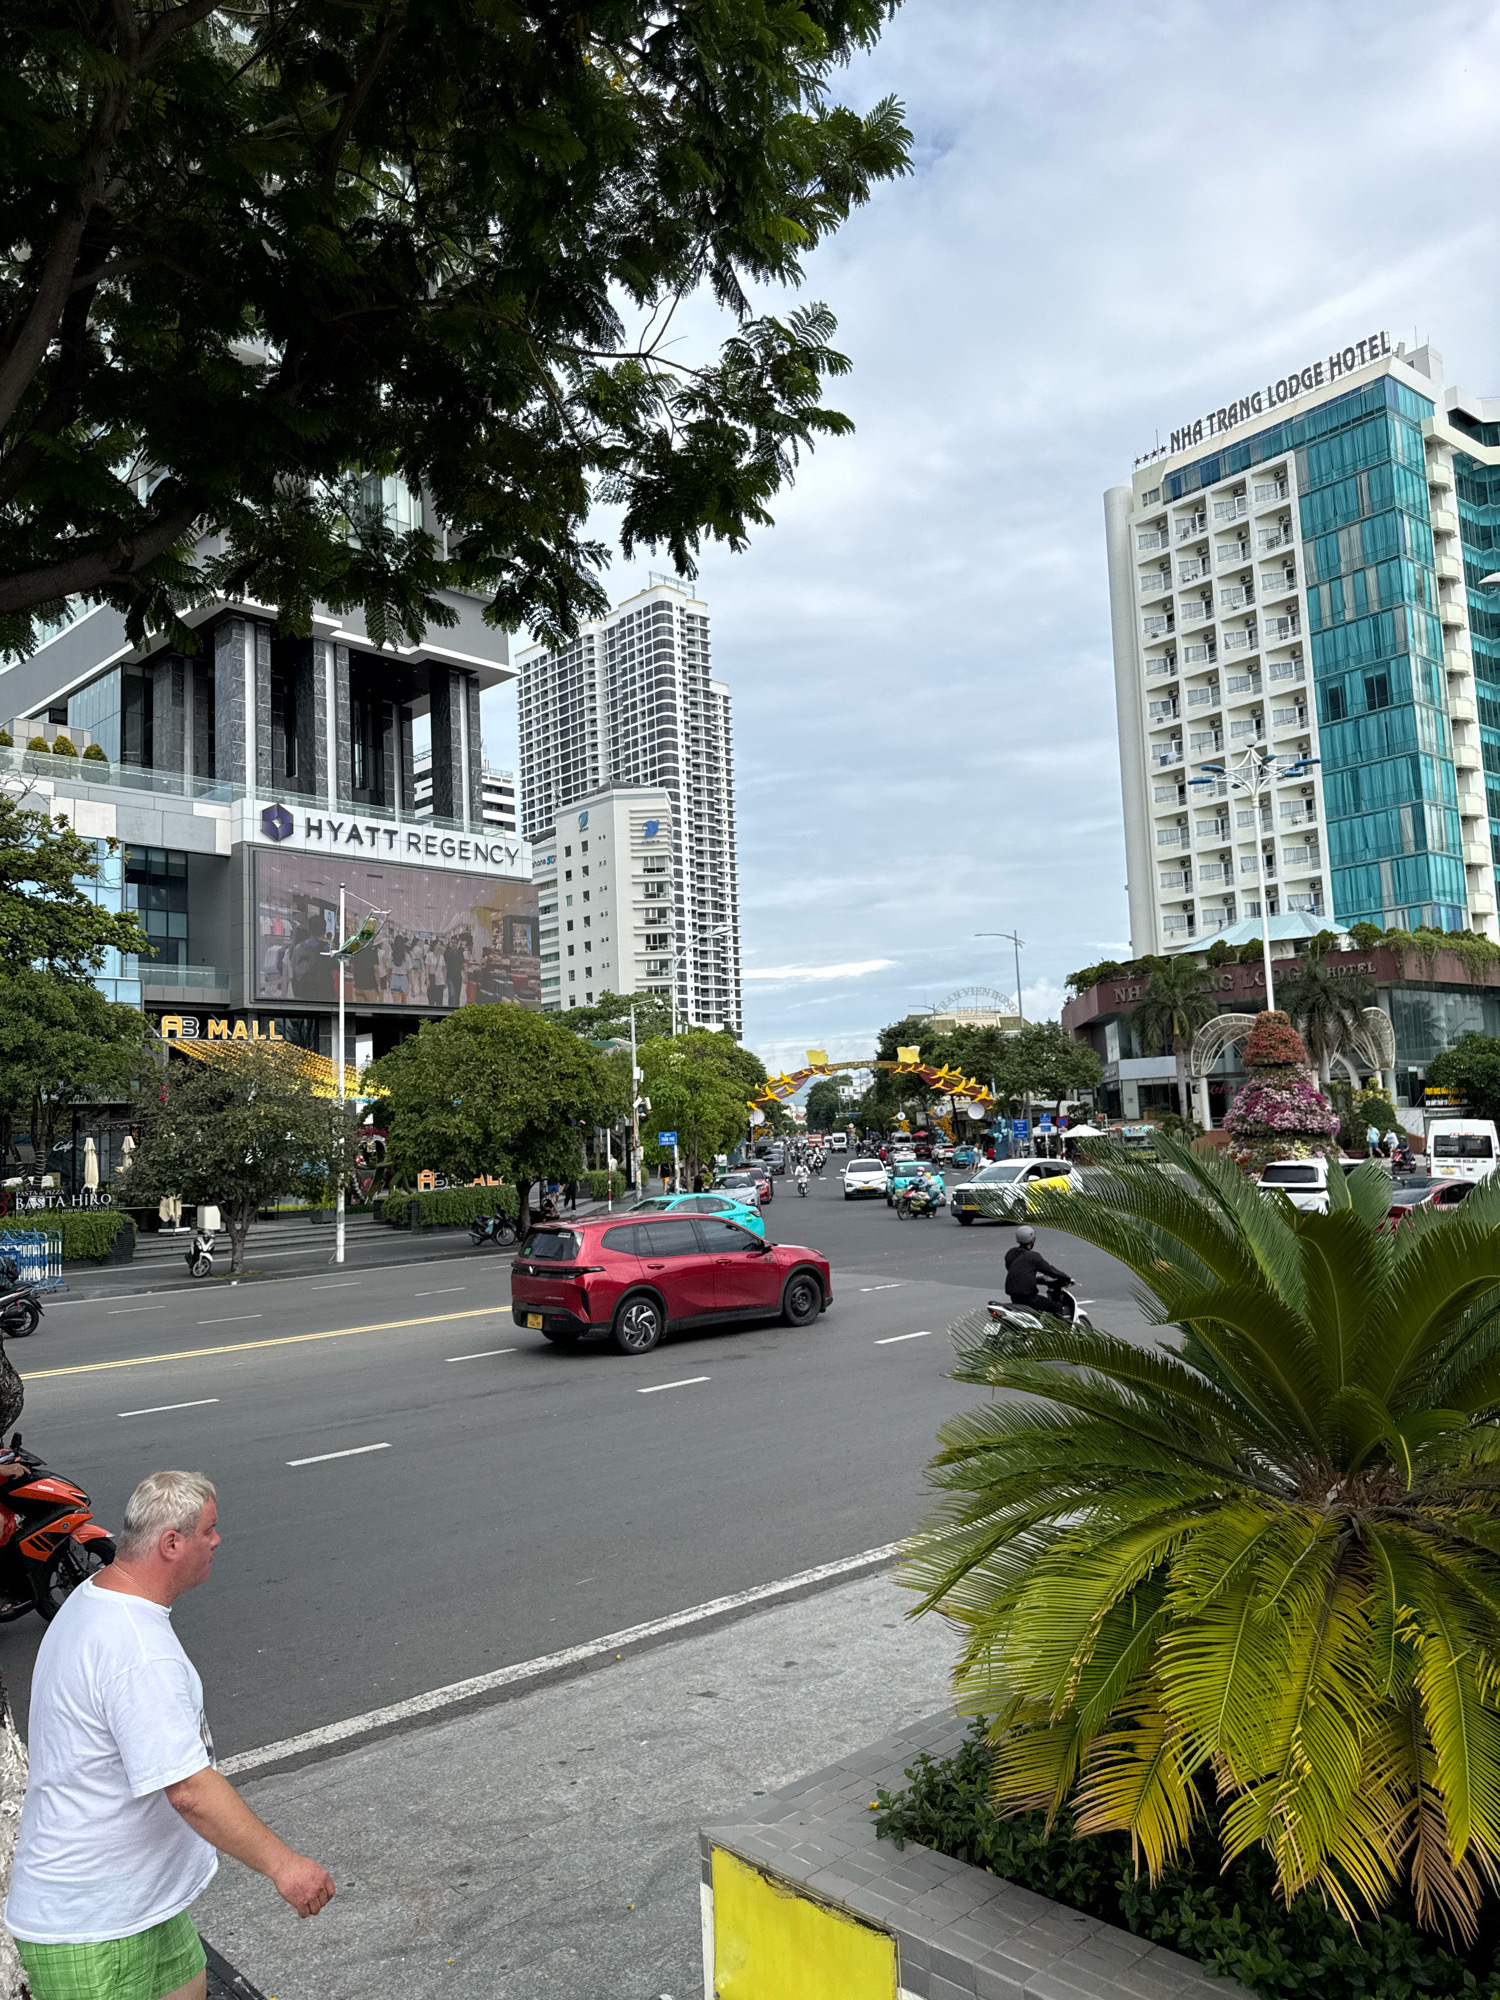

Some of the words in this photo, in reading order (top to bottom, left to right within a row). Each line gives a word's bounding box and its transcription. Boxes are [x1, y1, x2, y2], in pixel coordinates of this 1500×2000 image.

[1170, 419, 1203, 454] NHA
[1206, 391, 1263, 435] TRANG
[1267, 361, 1324, 408] LODGE
[1328, 331, 1391, 381] HOTEL
[305, 816, 398, 849] HYATT
[406, 832, 519, 866] REGENCY
[1241, 965, 1306, 989] LODG
[1326, 961, 1377, 979] HOTEL
[161, 1015, 199, 1039] AB
[207, 1019, 283, 1040] MALL
[15, 1195, 66, 1210] BASTA
